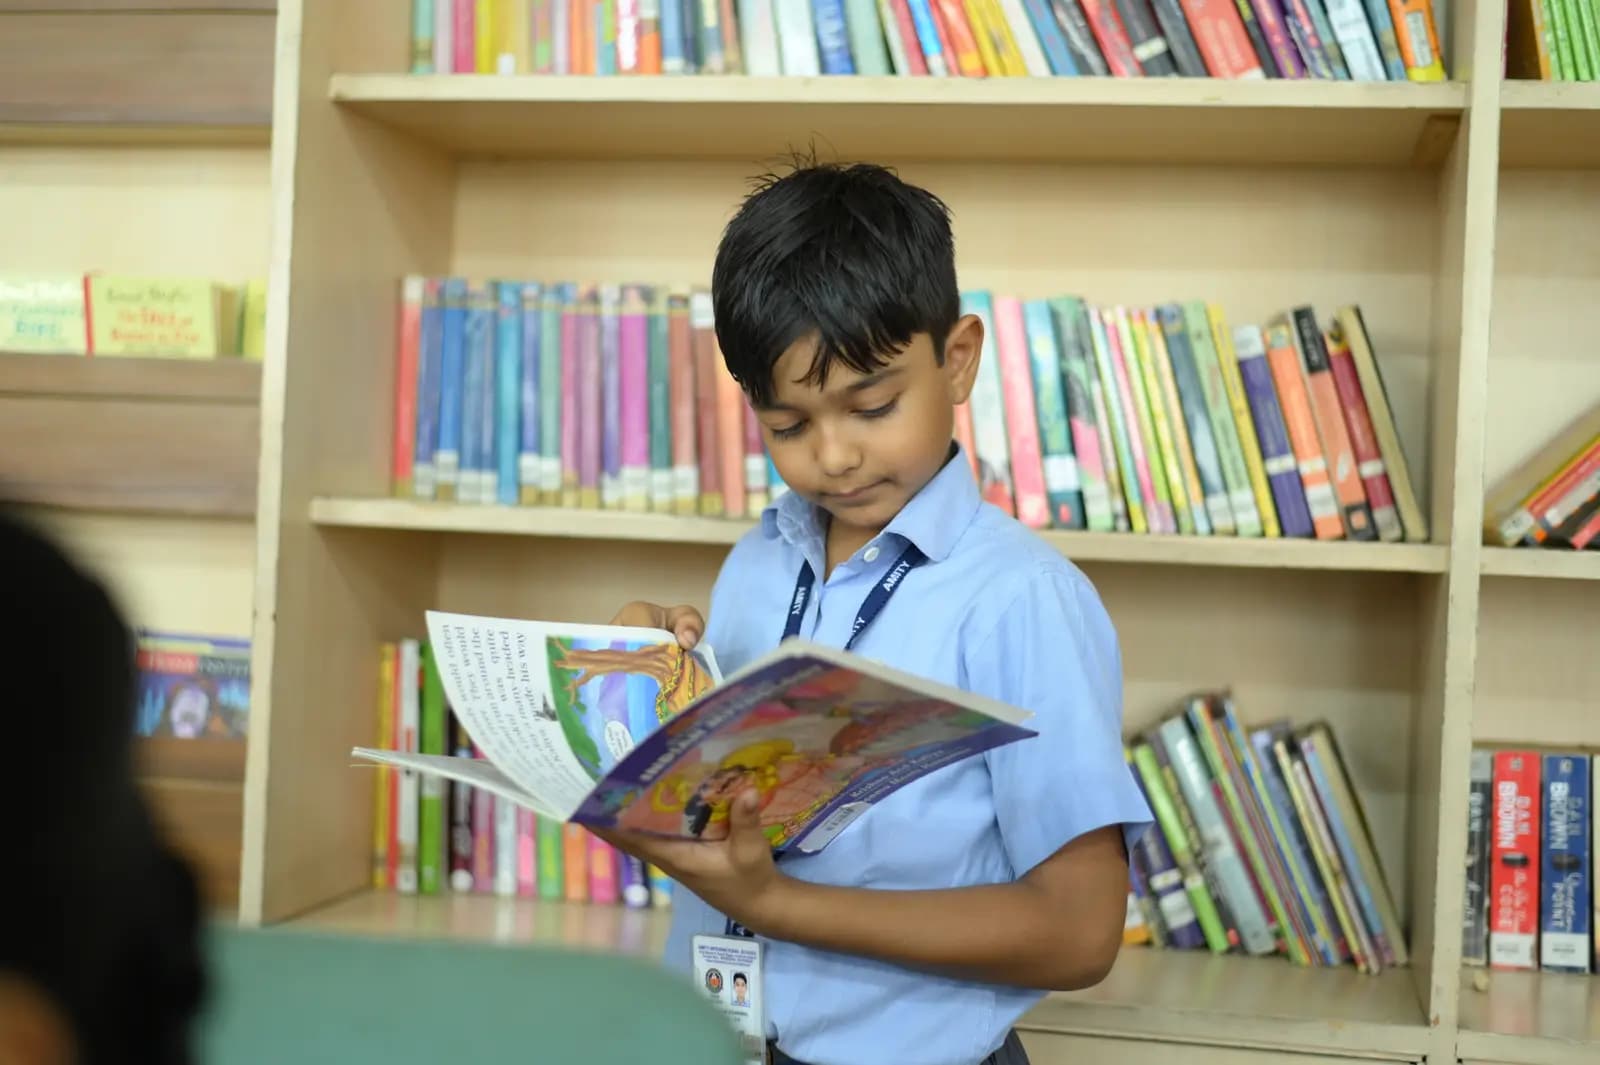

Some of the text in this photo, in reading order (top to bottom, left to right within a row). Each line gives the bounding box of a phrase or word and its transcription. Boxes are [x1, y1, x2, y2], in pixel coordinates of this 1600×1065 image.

[882, 560, 911, 592] AMITY
[454, 627, 471, 667] would
[471, 627, 481, 648] the
[486, 629, 502, 664] quite
[515, 632, 529, 658] way
[520, 663, 532, 682] his
[1498, 780, 1518, 848] BROWN
[1550, 781, 1569, 849] BROWN
